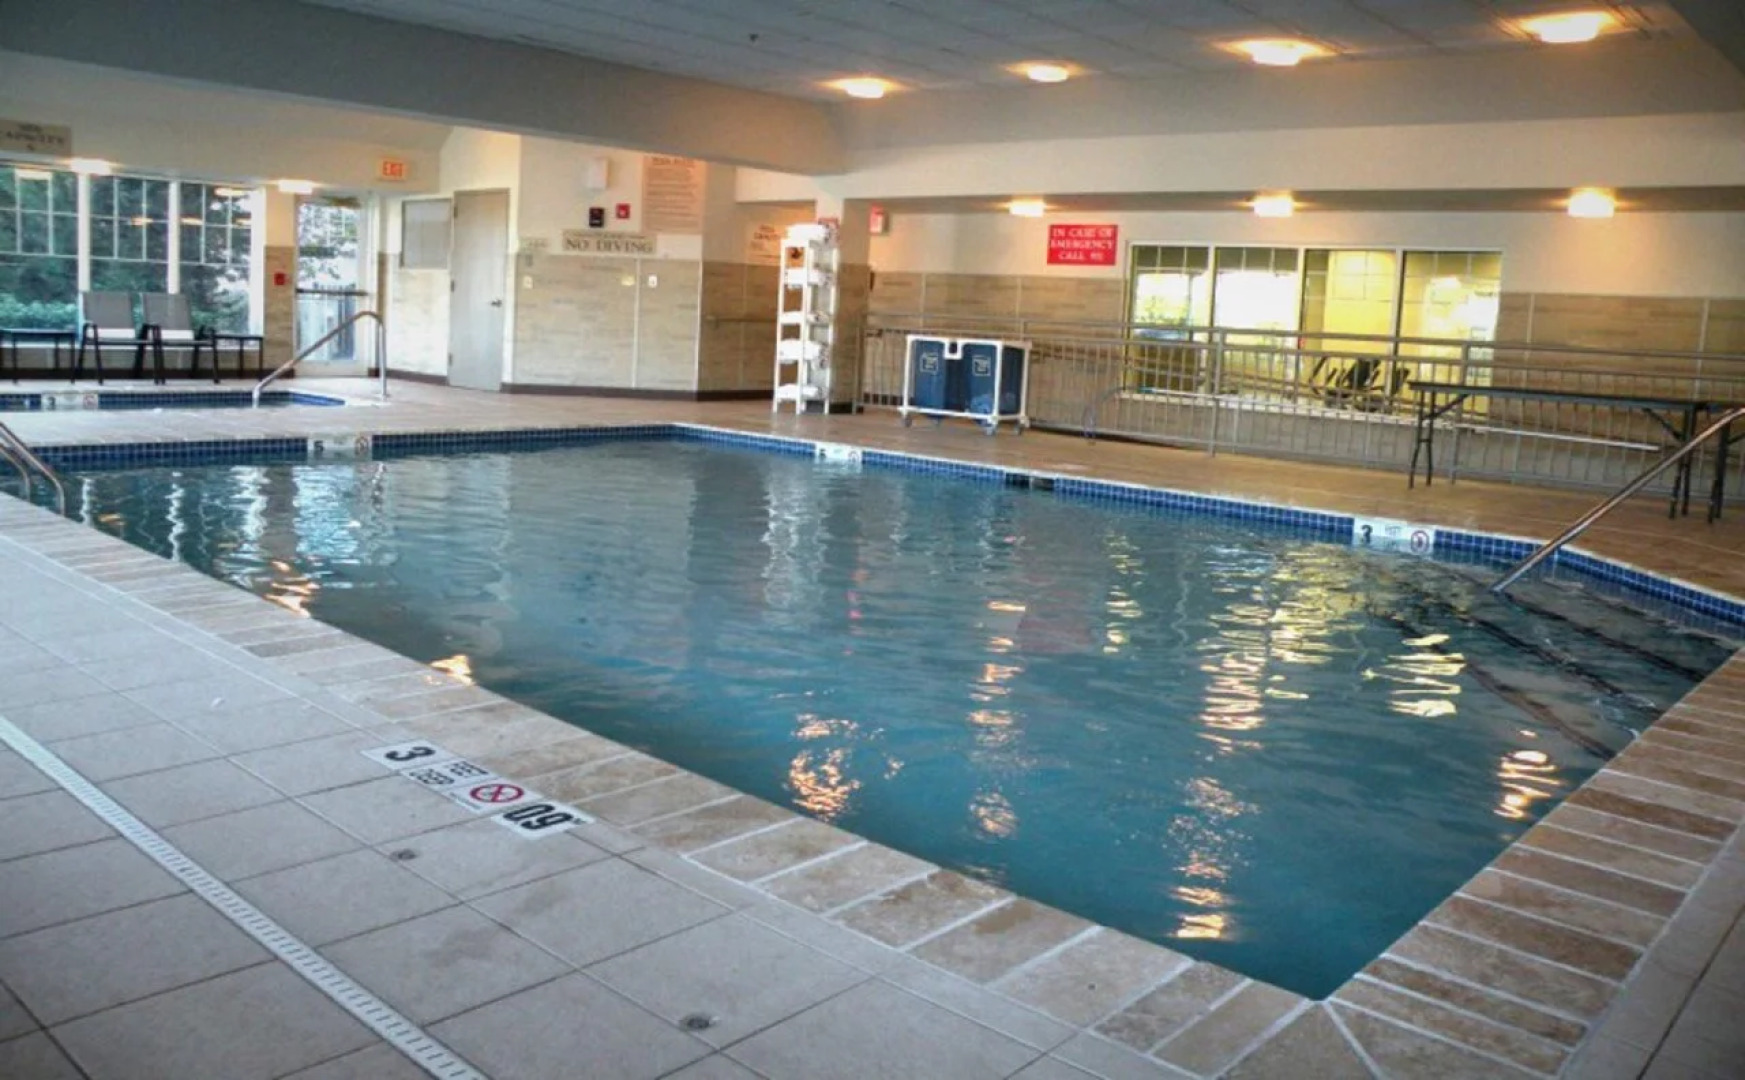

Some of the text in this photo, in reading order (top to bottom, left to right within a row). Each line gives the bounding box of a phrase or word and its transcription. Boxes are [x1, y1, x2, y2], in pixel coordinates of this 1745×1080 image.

[1053, 228, 1066, 237] IN
[1069, 228, 1096, 237] CASE
[565, 238, 654, 254] NO DIVING
[1050, 239, 1112, 249] EMERGENCY
[385, 746, 436, 762] 3
